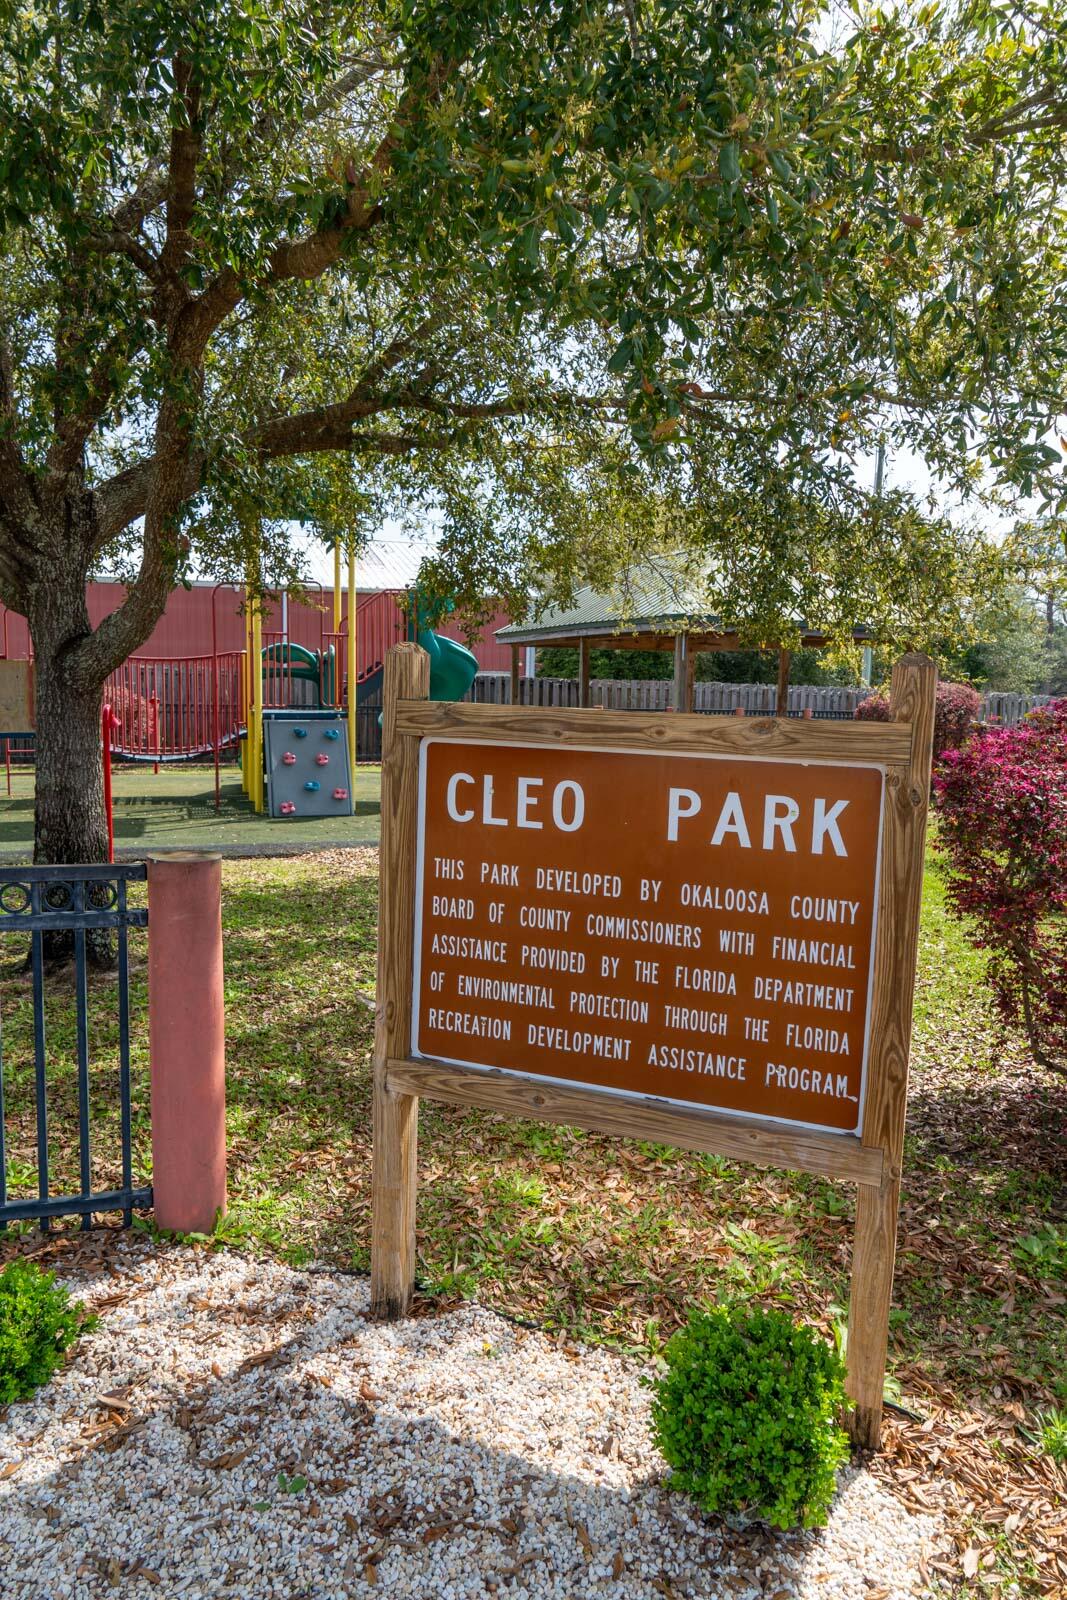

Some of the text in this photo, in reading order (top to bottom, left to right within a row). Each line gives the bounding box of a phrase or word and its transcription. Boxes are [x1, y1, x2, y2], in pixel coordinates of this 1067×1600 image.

[447, 773, 849, 856] CLEO PARK
[435, 858, 859, 924] THIS PARK DEVELOPED BY OKALOOSA COUNTY
[433, 896, 855, 968] BOARD OF COUNTY COMMISSIONERS WITH FINANCIAL
[432, 935, 853, 1011] ASSISTANCE PROVIDED BY THE FLORIDA DEPARTMENT
[429, 1008, 511, 1040] RECREATION
[528, 1025, 631, 1060] DEVELOPMENT
[648, 1045, 746, 1080] ASSISTANCE
[431, 972, 848, 1054] OF ENVIRONMENTAL PROTECTION THROUGH THE FLORIDA
